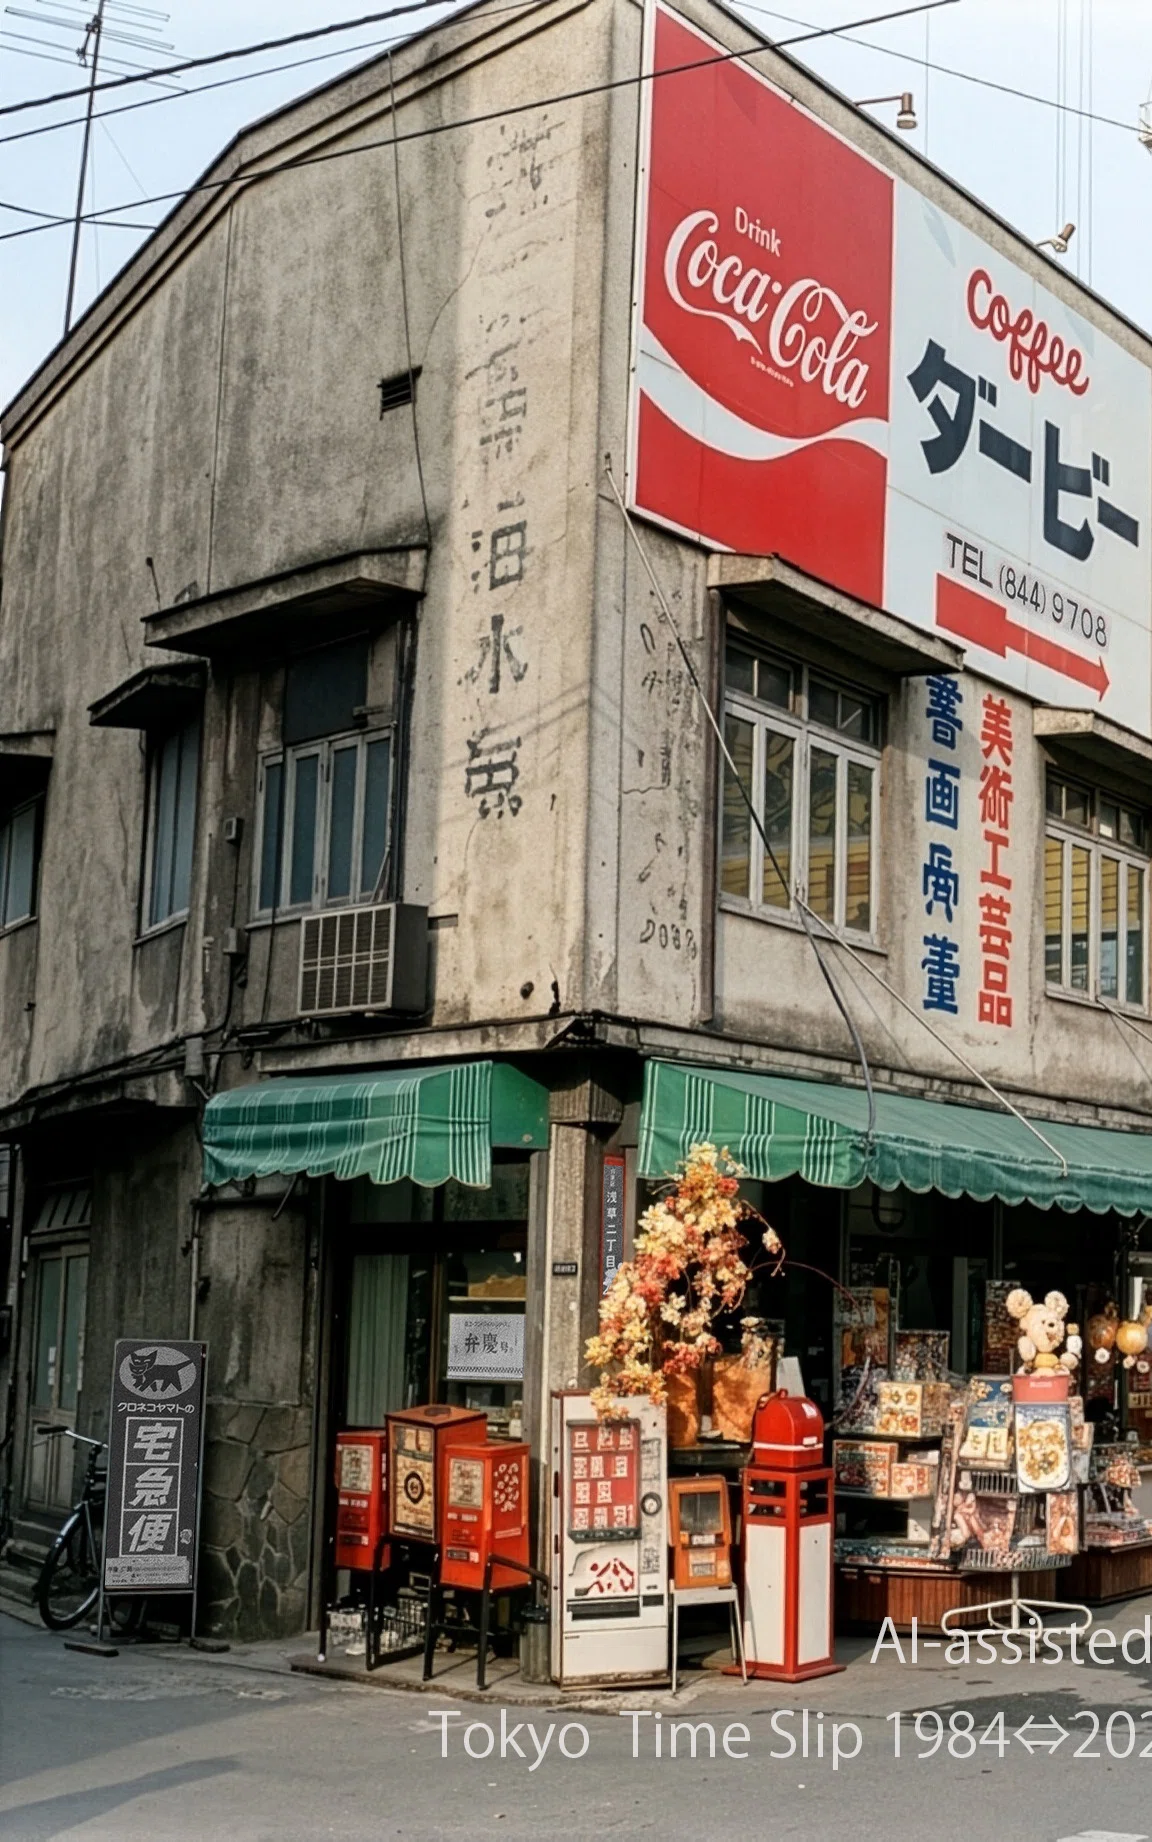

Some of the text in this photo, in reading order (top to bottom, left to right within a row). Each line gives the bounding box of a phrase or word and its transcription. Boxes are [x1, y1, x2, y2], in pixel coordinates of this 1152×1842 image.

[734, 206, 782, 257] Drink
[966, 268, 1091, 394] Coffee
[906, 339, 1141, 562] ダービー
[947, 532, 1107, 648] TEL (844) 9708
[978, 693, 1015, 1028] 美術工芸品
[117, 1402, 195, 1413] クロネコヤマトの
[128, 1422, 178, 1553] 宅急便
